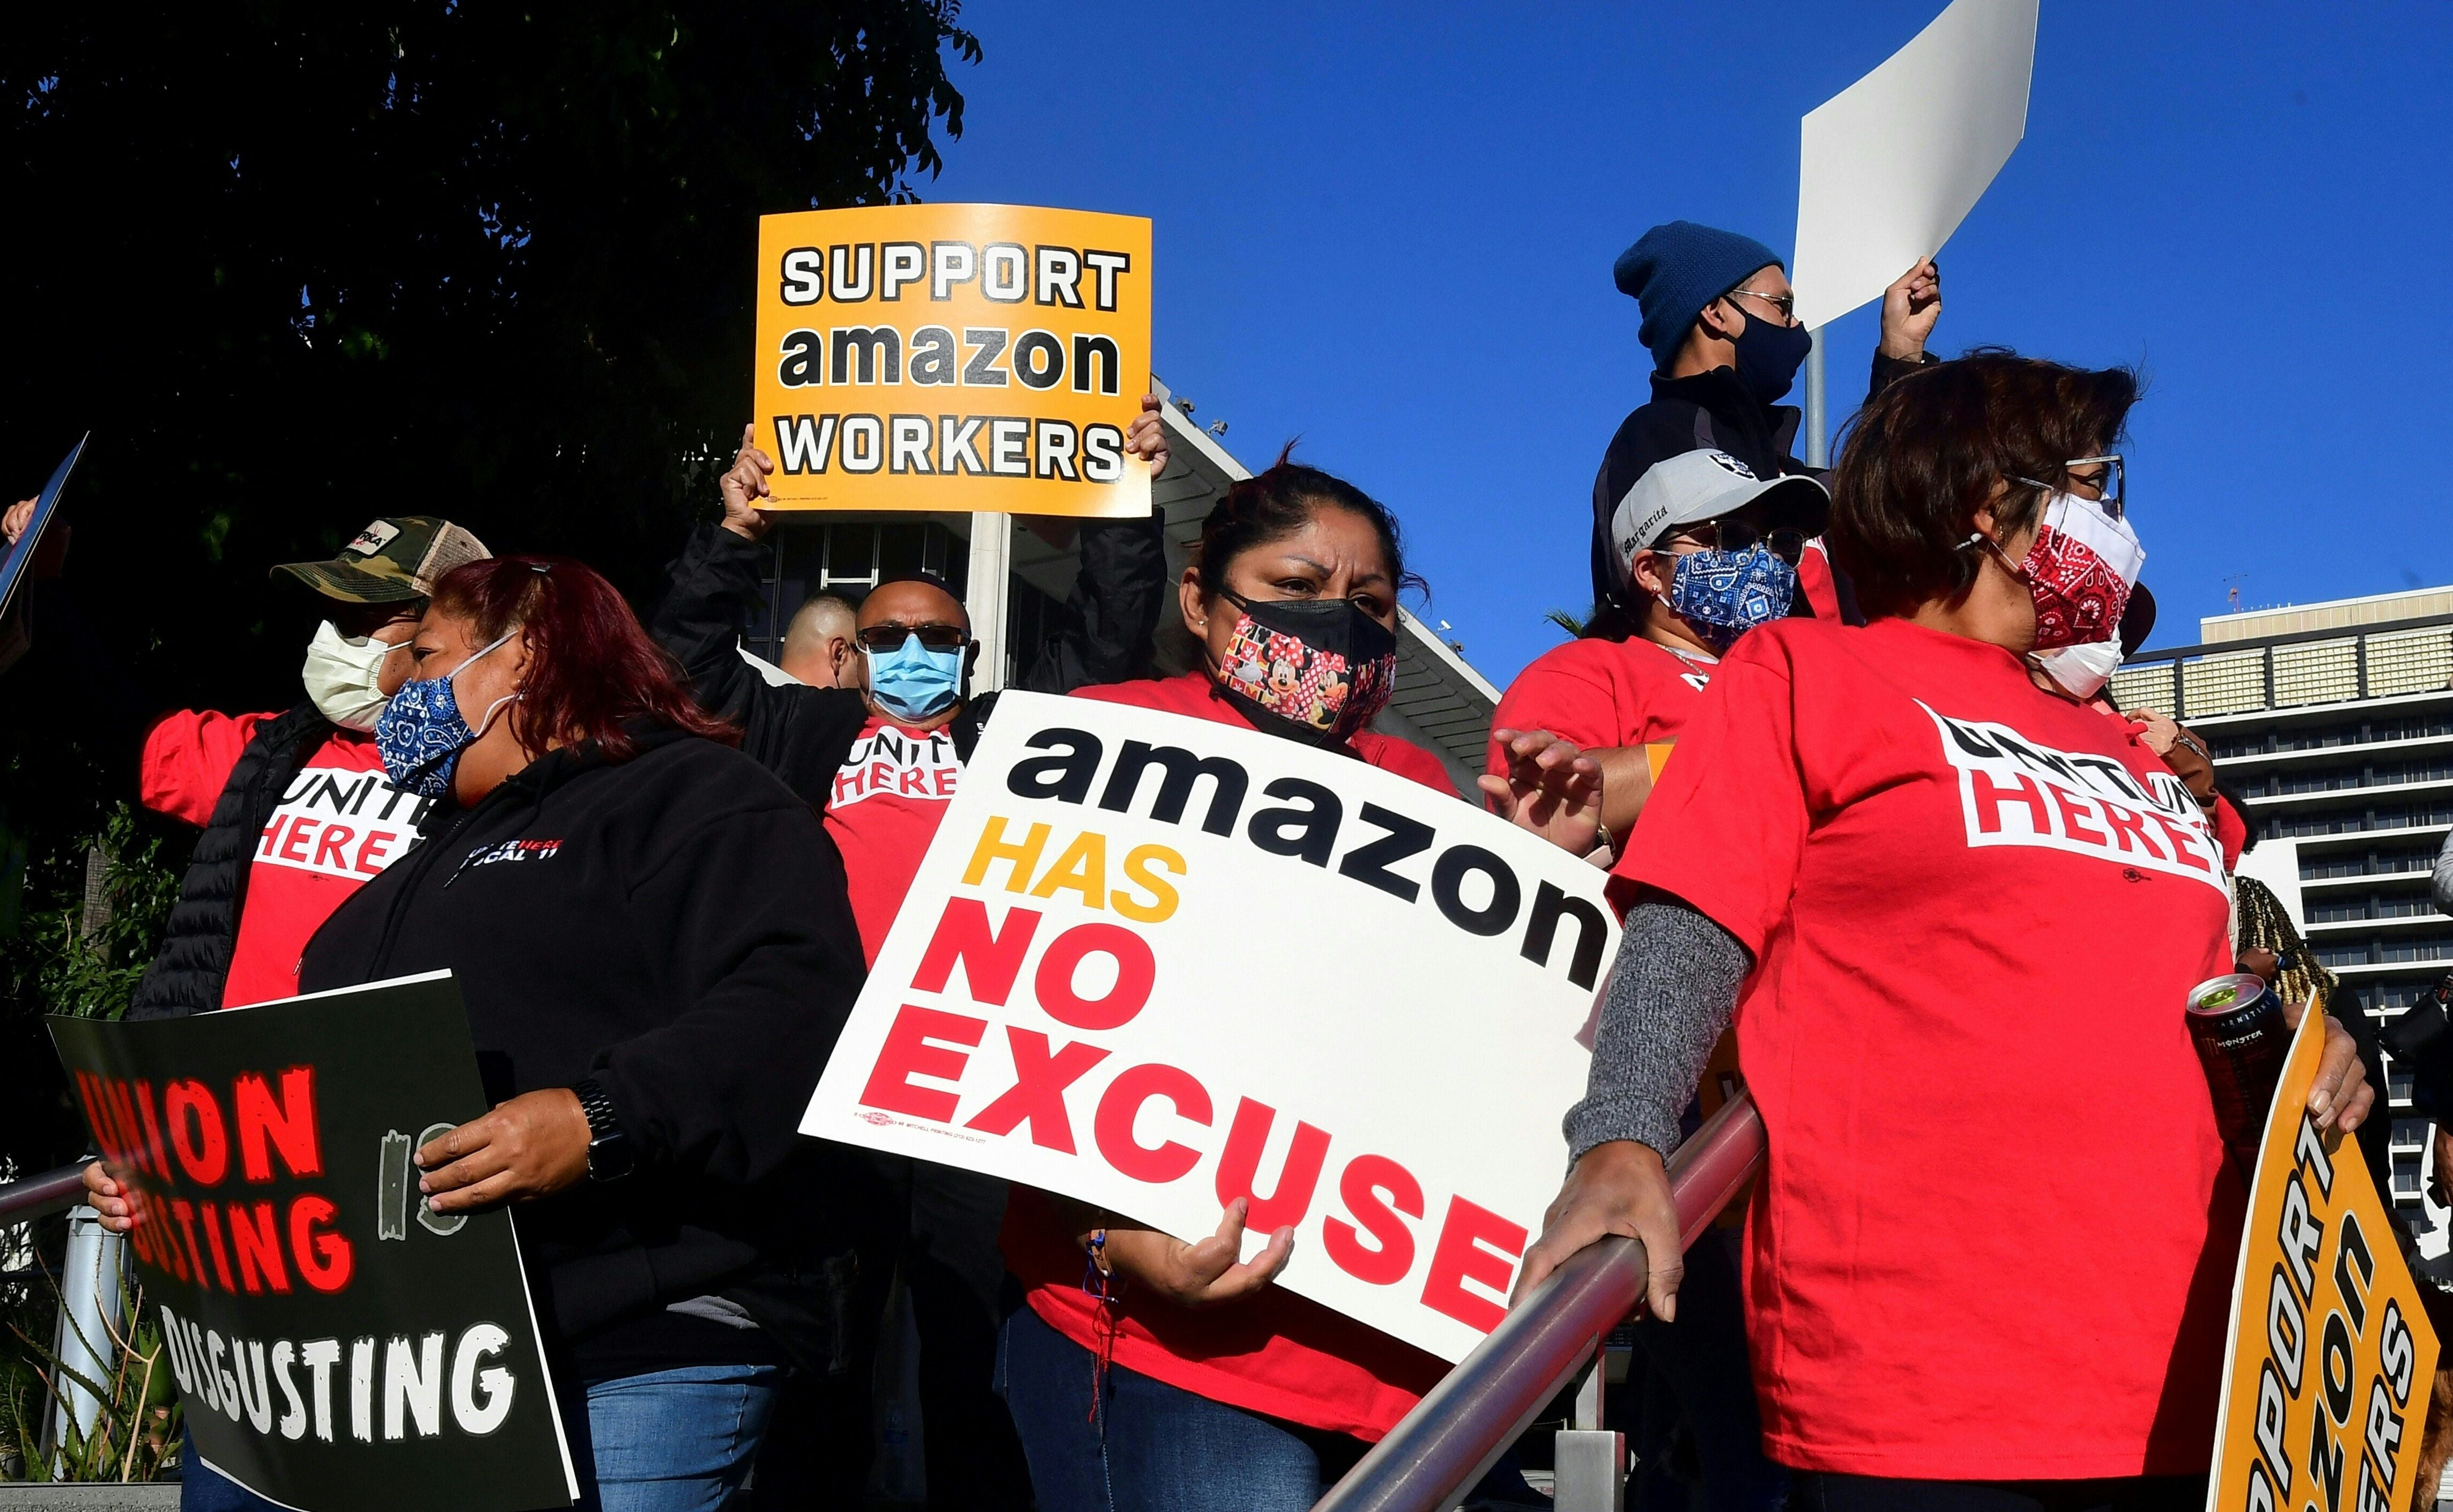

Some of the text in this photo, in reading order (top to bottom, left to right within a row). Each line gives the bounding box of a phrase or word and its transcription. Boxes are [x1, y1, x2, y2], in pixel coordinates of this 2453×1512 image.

[780, 242, 1130, 312] SUPPORT
[777, 324, 1121, 396] amazon
[773, 413, 1124, 484] WORKERS
[1624, 505, 1668, 558] Margarita
[841, 732, 948, 766] UNIT
[538, 848, 558, 859] 11
[961, 816, 1187, 923] HAS
[1007, 727, 1608, 993] amazon
[910, 896, 1155, 1030] NO
[2217, 1029, 2263, 1047] MONSTER
[75, 1065, 322, 1186] UNION
[859, 1004, 1529, 1335] EXCUSE
[160, 1305, 515, 1443] DISGUSTING
